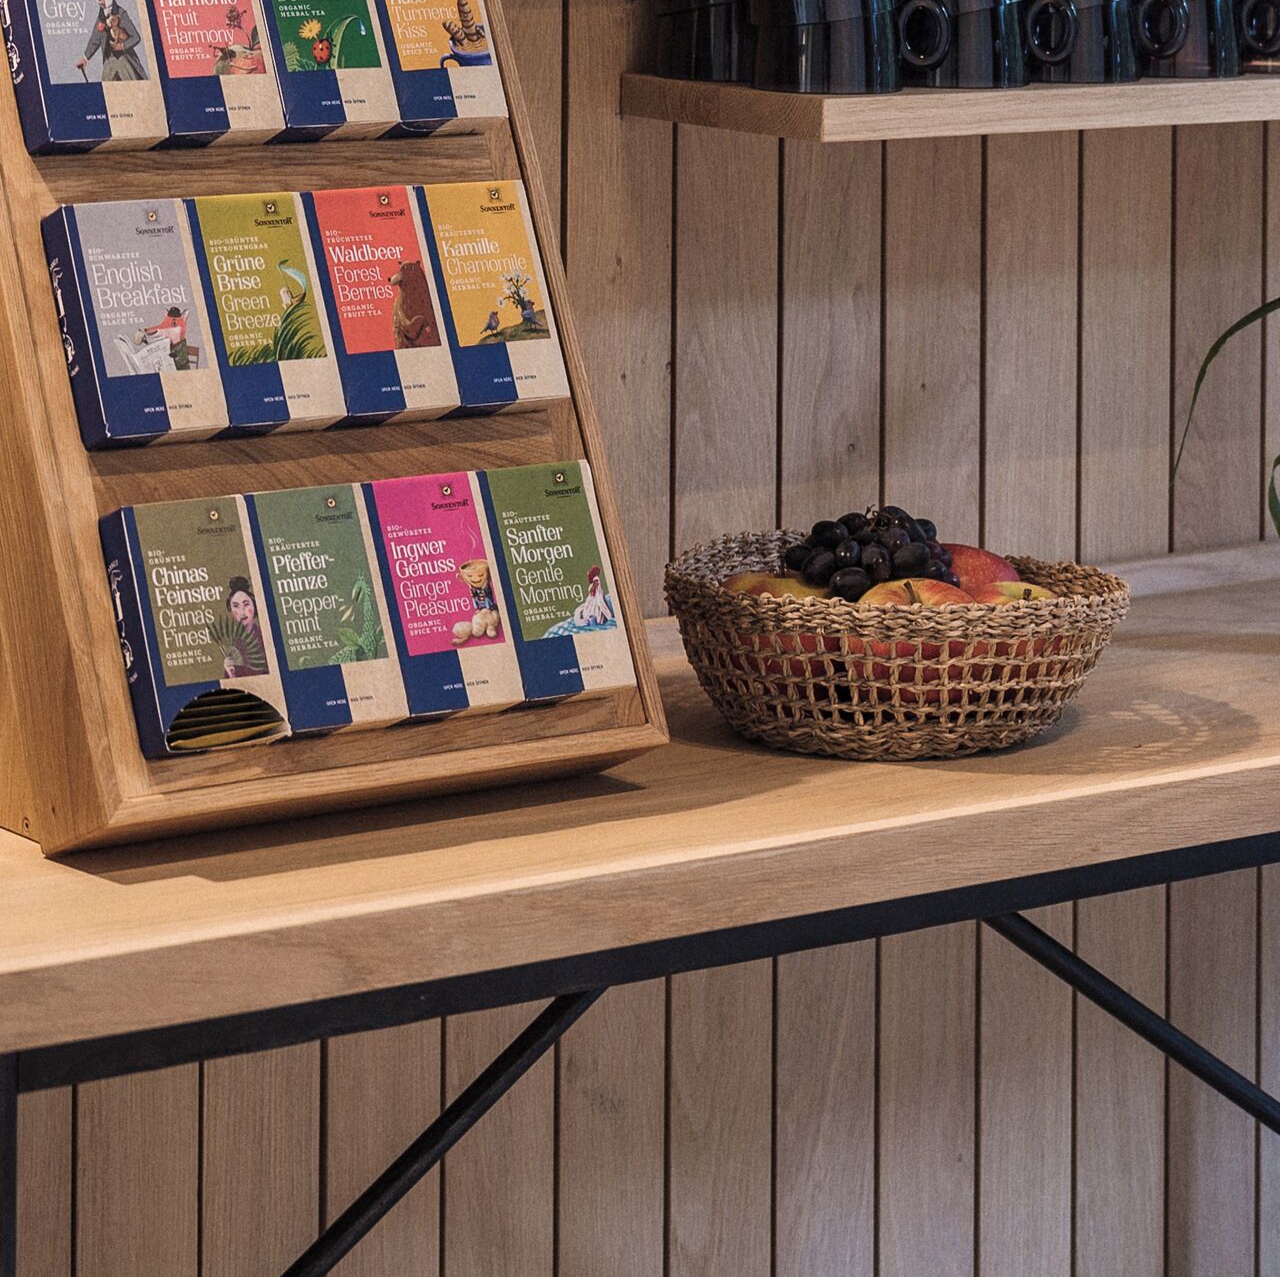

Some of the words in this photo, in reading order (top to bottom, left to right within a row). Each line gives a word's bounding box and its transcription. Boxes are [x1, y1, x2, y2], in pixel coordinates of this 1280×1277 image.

[162, 9, 199, 27] Fruit
[392, 4, 458, 22] Turmeric
[166, 27, 234, 44] Harmony
[396, 23, 427, 40] Kiss
[329, 244, 403, 264] Waldbeer
[442, 237, 500, 257] Kamille
[92, 260, 162, 289] English
[213, 254, 266, 274] Grüne
[334, 265, 383, 284] Forest
[446, 254, 527, 276] Chamomile
[216, 273, 262, 292] Brise
[337, 281, 394, 302] Berries
[97, 283, 188, 309] Breakfast
[221, 294, 271, 313] Green
[225, 313, 281, 332] Breeze
[506, 524, 564, 546] Sanfter
[390, 539, 447, 562] Ingwer
[510, 544, 573, 565] Morgen
[272, 551, 335, 574] Pfeffer-
[395, 558, 456, 579] Genuss
[151, 566, 209, 587] Chinas
[276, 573, 328, 594] minze
[515, 564, 564, 586] Gentle
[155, 585, 223, 607] Feinster
[400, 579, 451, 601] Ginger
[520, 582, 584, 605] Morning
[280, 594, 345, 617] Pepper-
[404, 597, 471, 619] Pleasure
[159, 605, 215, 629] China's
[285, 613, 322, 635] mint
[163, 627, 212, 649] Finest
